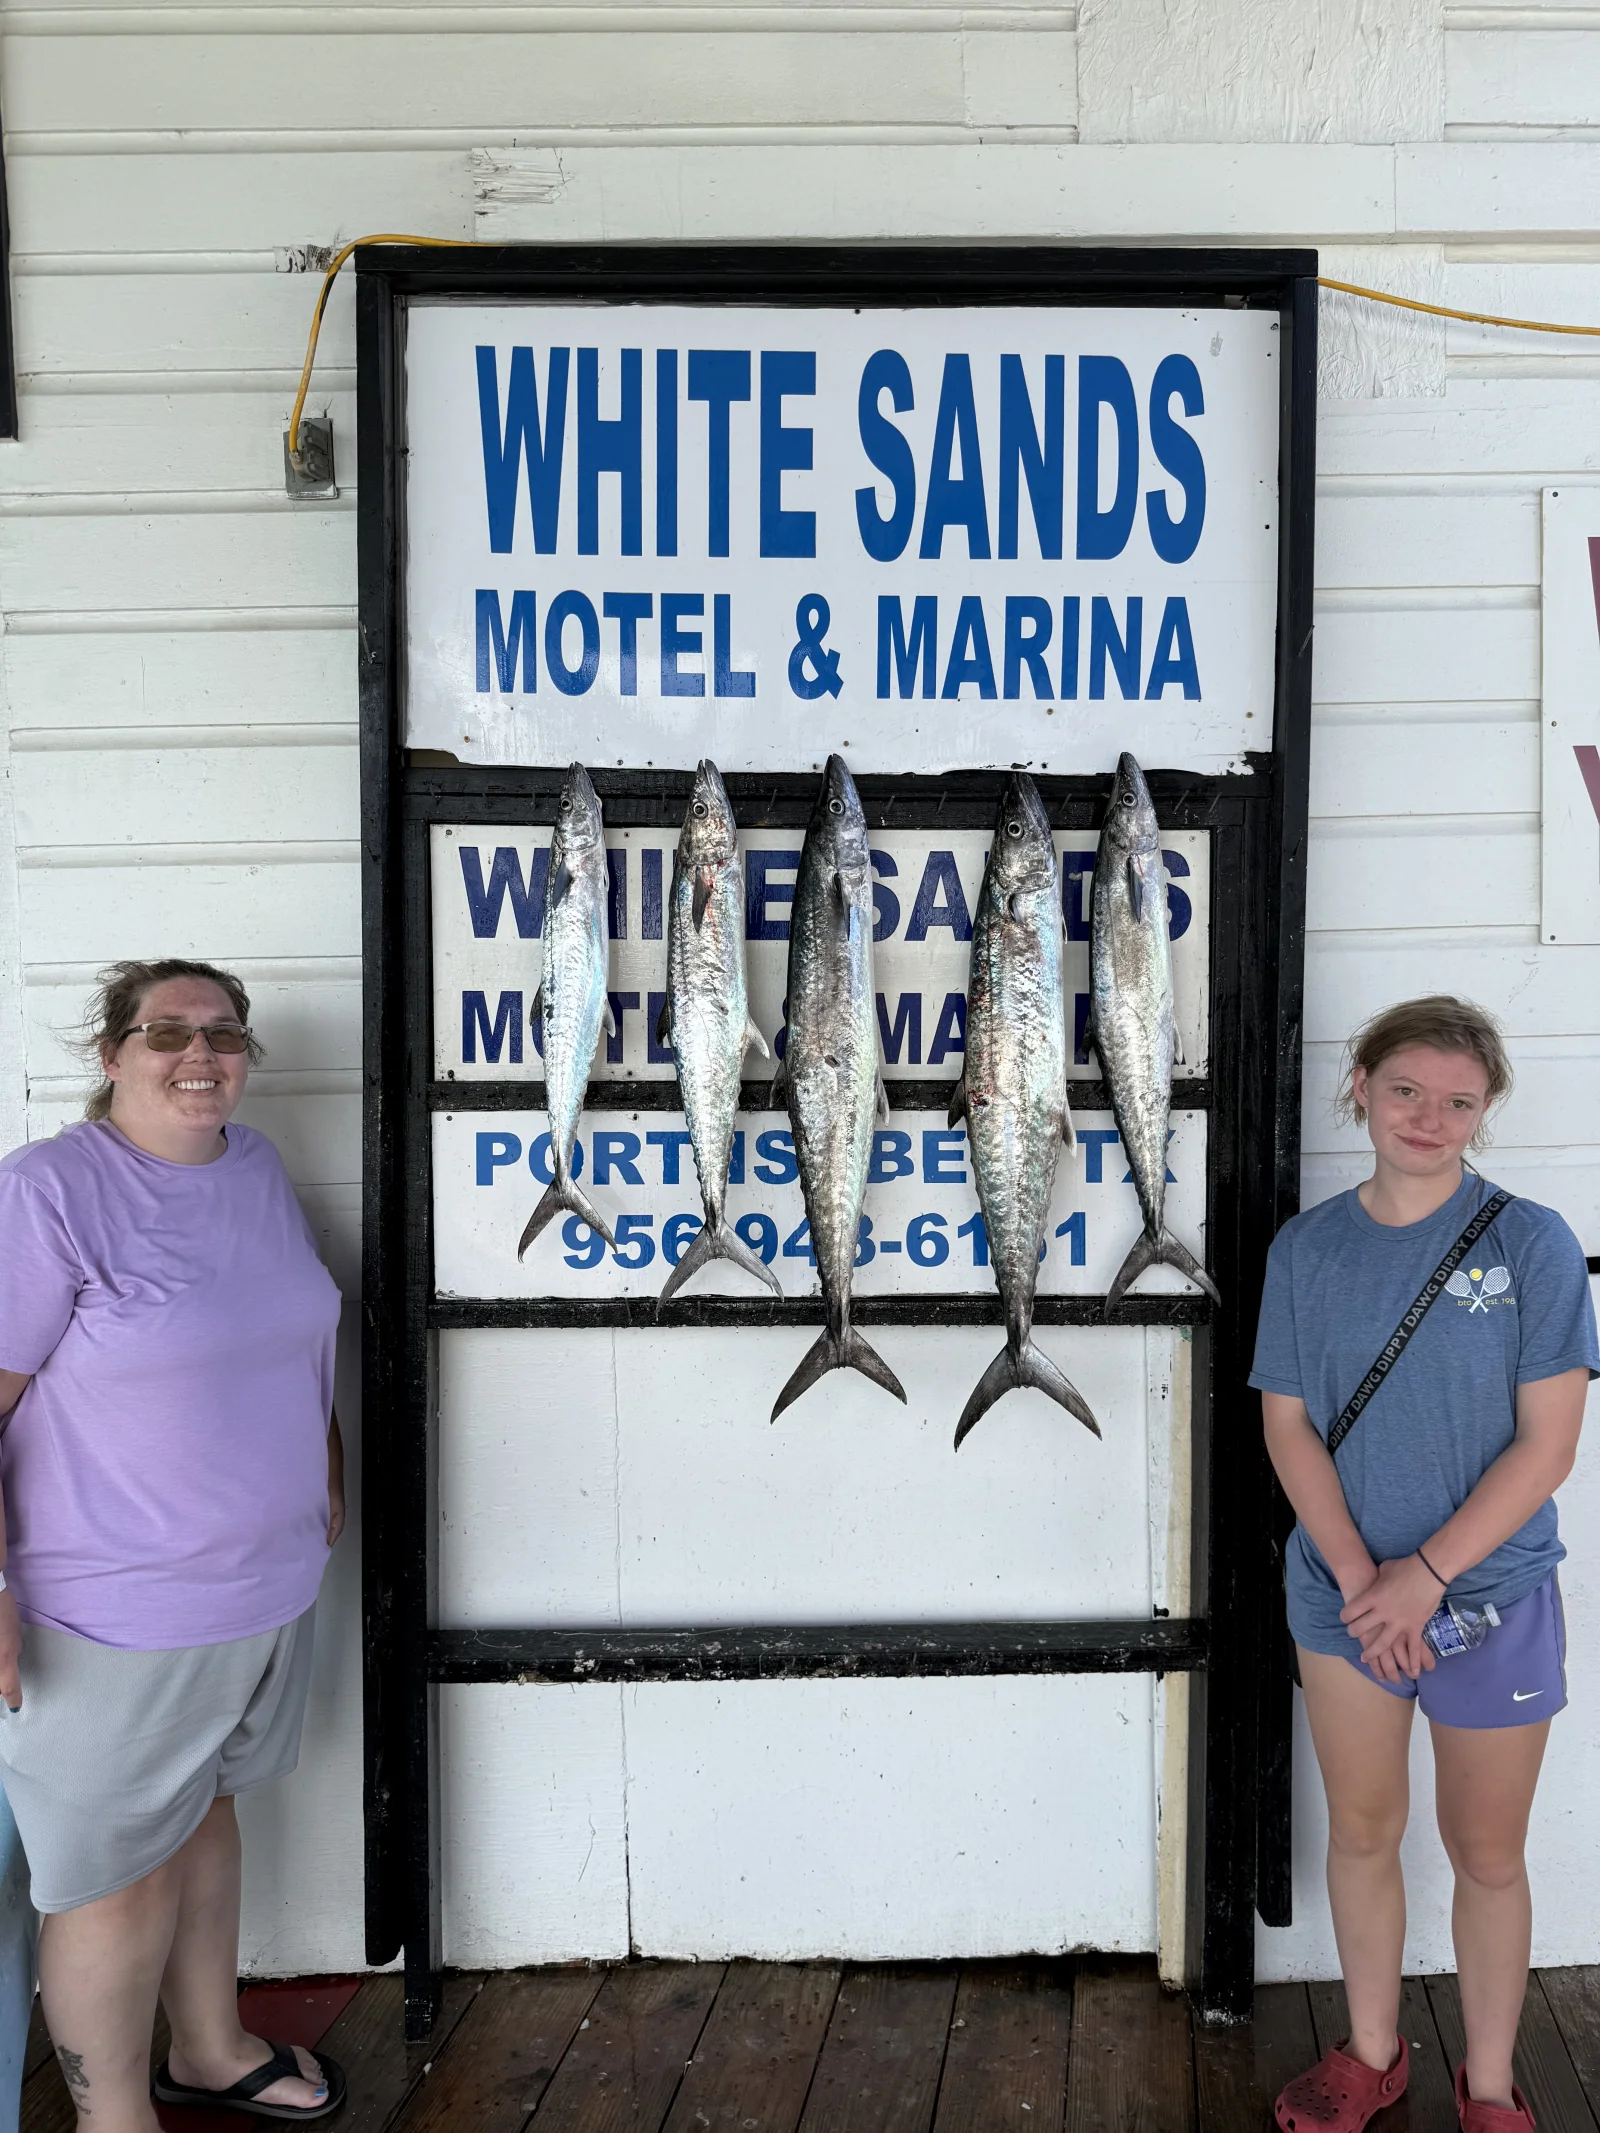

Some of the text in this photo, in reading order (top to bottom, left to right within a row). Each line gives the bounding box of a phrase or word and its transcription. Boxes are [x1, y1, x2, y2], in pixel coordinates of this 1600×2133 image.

[475, 346, 1206, 565] WHITE SANDS
[474, 589, 1202, 702] MOTEL & MARINA
[458, 846, 802, 941] WIE
[1329, 1408, 1354, 1448] DIPPY
[1351, 1372, 1382, 1411] DAWG
[1376, 1327, 1409, 1372] DIPPY
[1404, 1282, 1439, 1328] DAWG
[1434, 1239, 1469, 1283] DIPPY
[1465, 1199, 1500, 1240] DAWG
